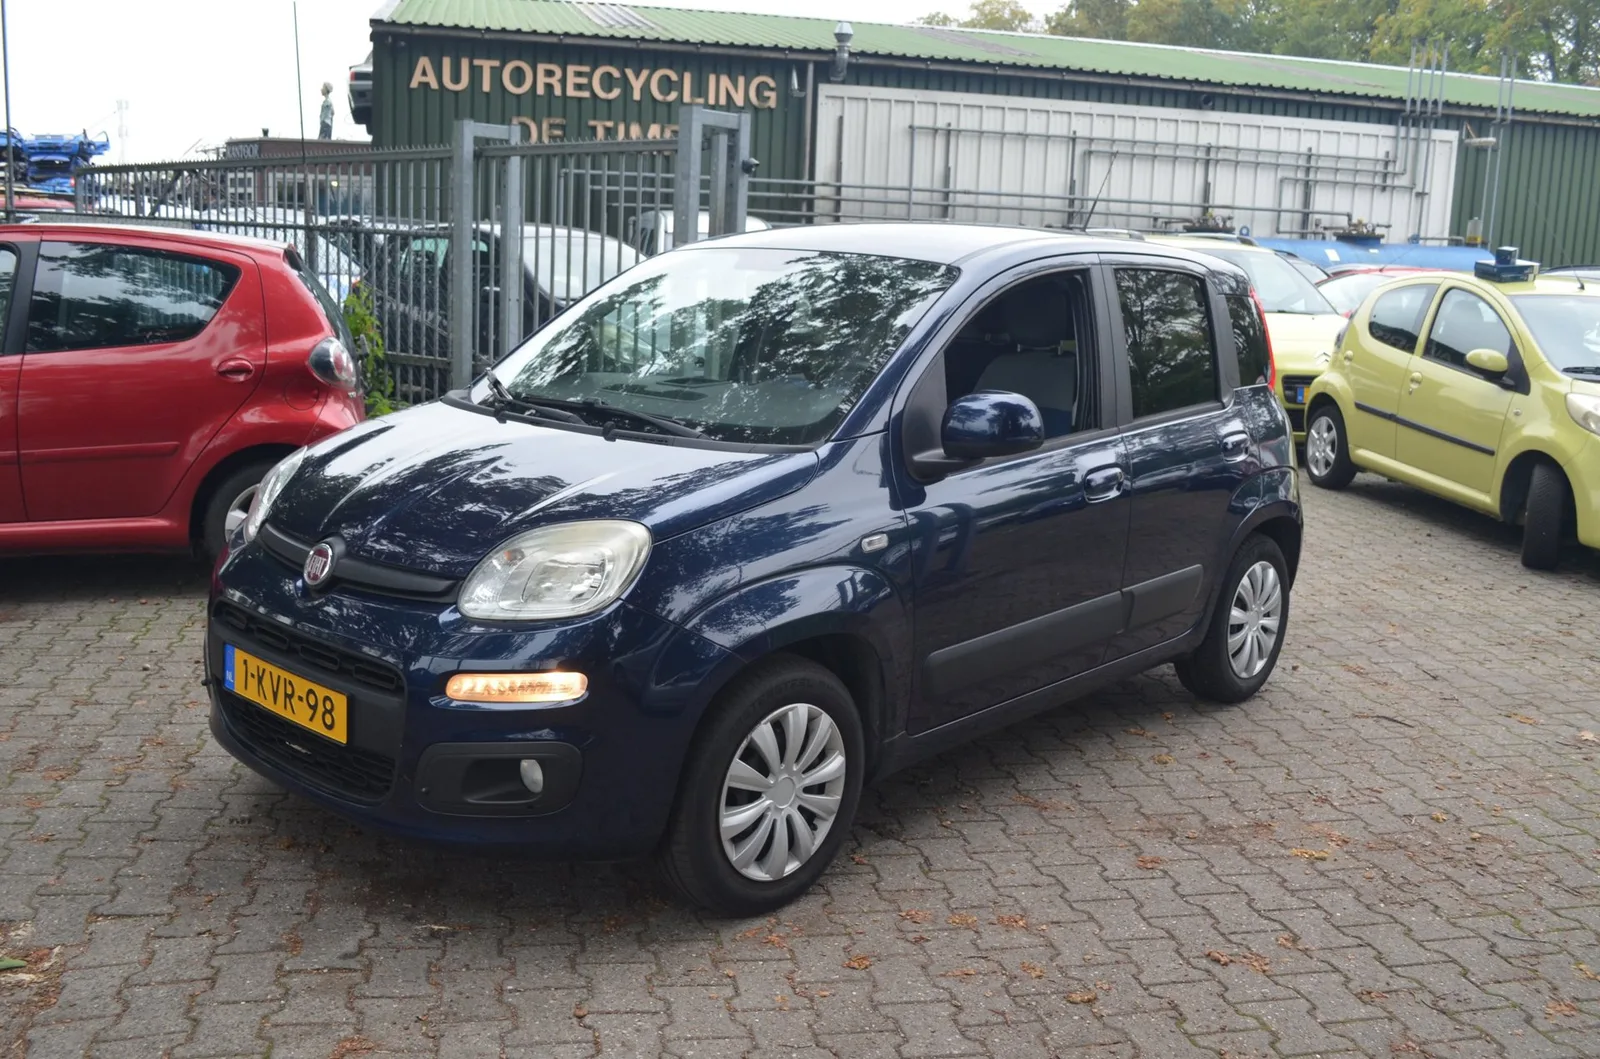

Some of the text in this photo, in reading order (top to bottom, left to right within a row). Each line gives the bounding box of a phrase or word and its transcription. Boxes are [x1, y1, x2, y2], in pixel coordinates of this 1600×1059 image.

[410, 56, 777, 109] AUTORECYCLING
[511, 116, 566, 146] DE
[242, 658, 336, 731] 1-KVR-98
